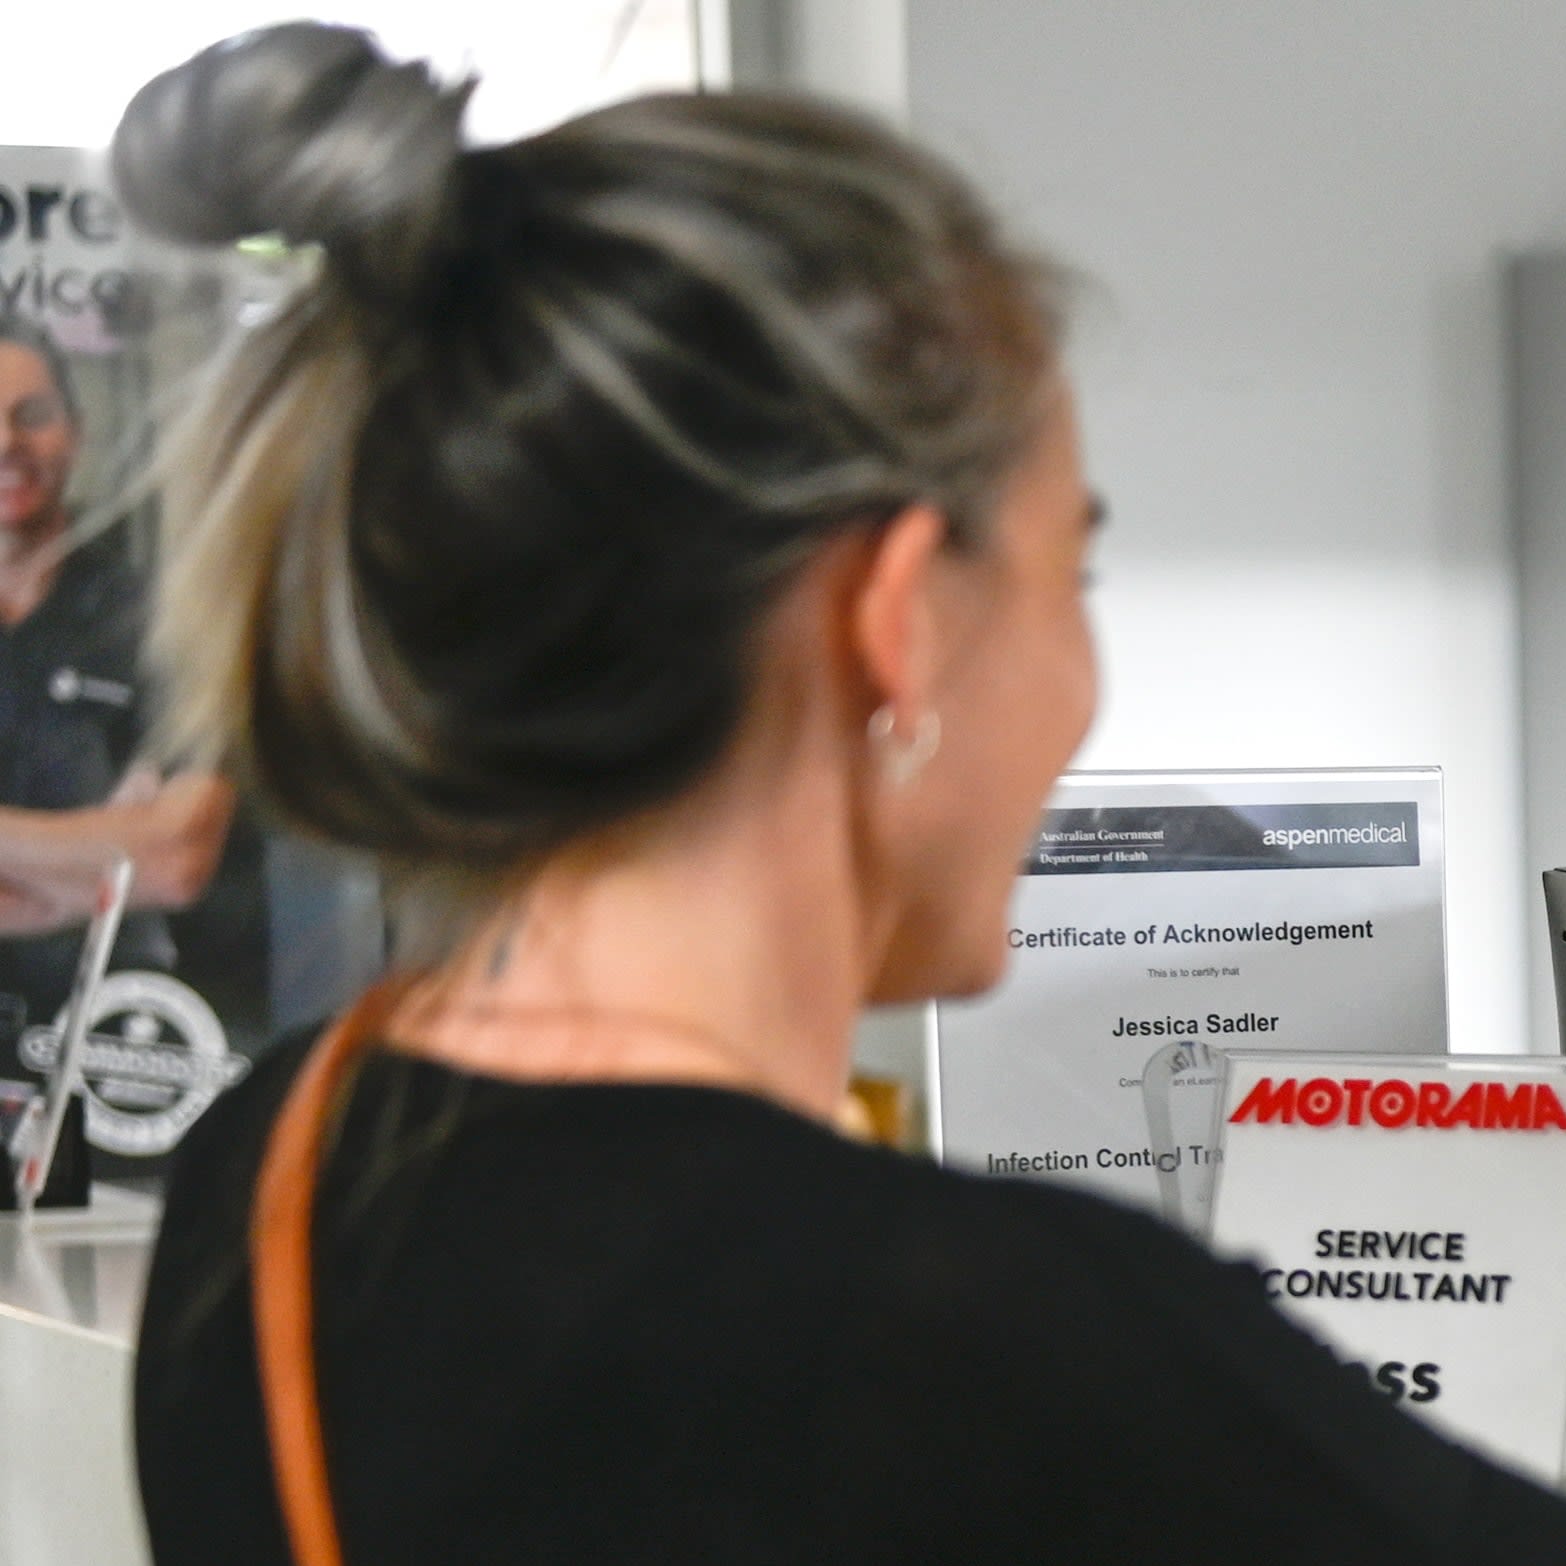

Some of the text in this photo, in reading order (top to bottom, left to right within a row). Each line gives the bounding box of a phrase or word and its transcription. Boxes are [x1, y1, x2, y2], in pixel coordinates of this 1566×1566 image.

[1039, 828, 1165, 842] Australian Government
[1262, 821, 1407, 851] aspenmedical
[1039, 851, 1149, 866] Department of Health
[1007, 920, 1374, 948] Certificate of Acknowledgement
[1147, 966, 1240, 978] This is to certify that
[1112, 1012, 1280, 1037] Jessica Sadler
[988, 1152, 1089, 1174] Infection
[1315, 1229, 1465, 1261] SERVICE
[1262, 1269, 1512, 1304] CONSULTANT
